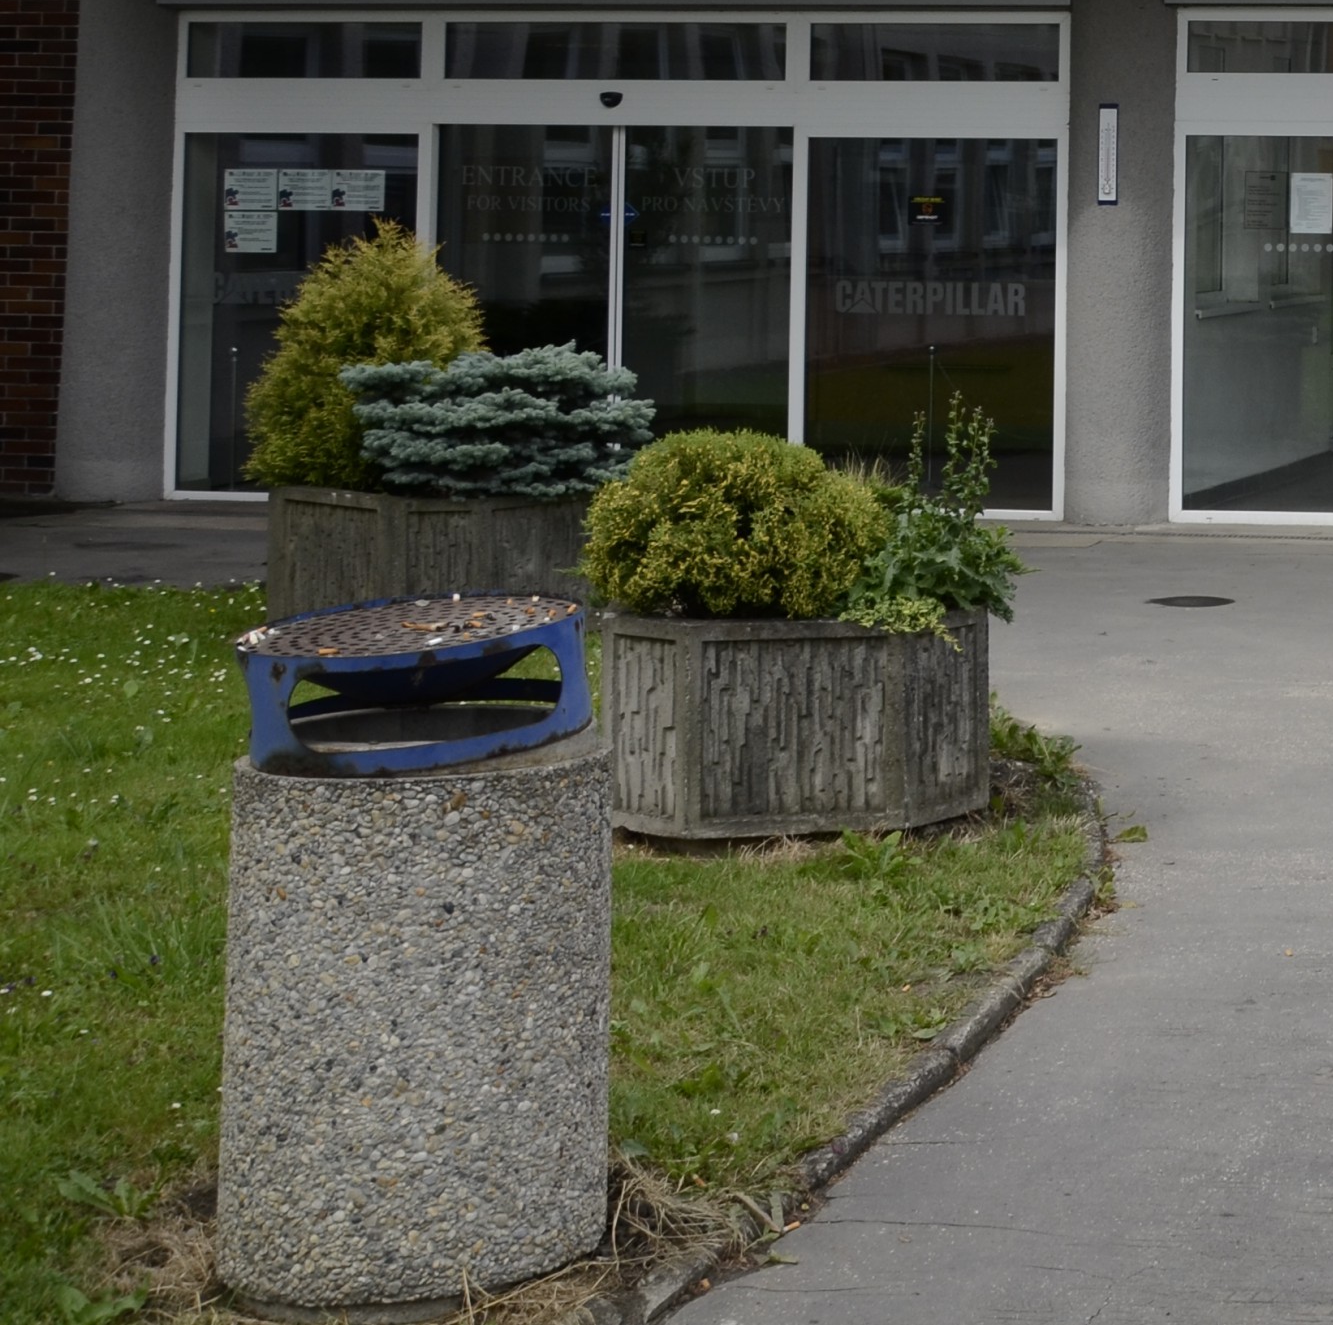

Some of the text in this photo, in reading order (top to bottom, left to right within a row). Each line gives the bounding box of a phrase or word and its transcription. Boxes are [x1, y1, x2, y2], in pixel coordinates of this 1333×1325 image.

[462, 165, 597, 187] ENTRANCE
[673, 168, 756, 189] VSTUP
[467, 196, 591, 213] FOR VISITORS
[641, 196, 678, 213] PRO
[835, 279, 1026, 316] CATERPILLAR
